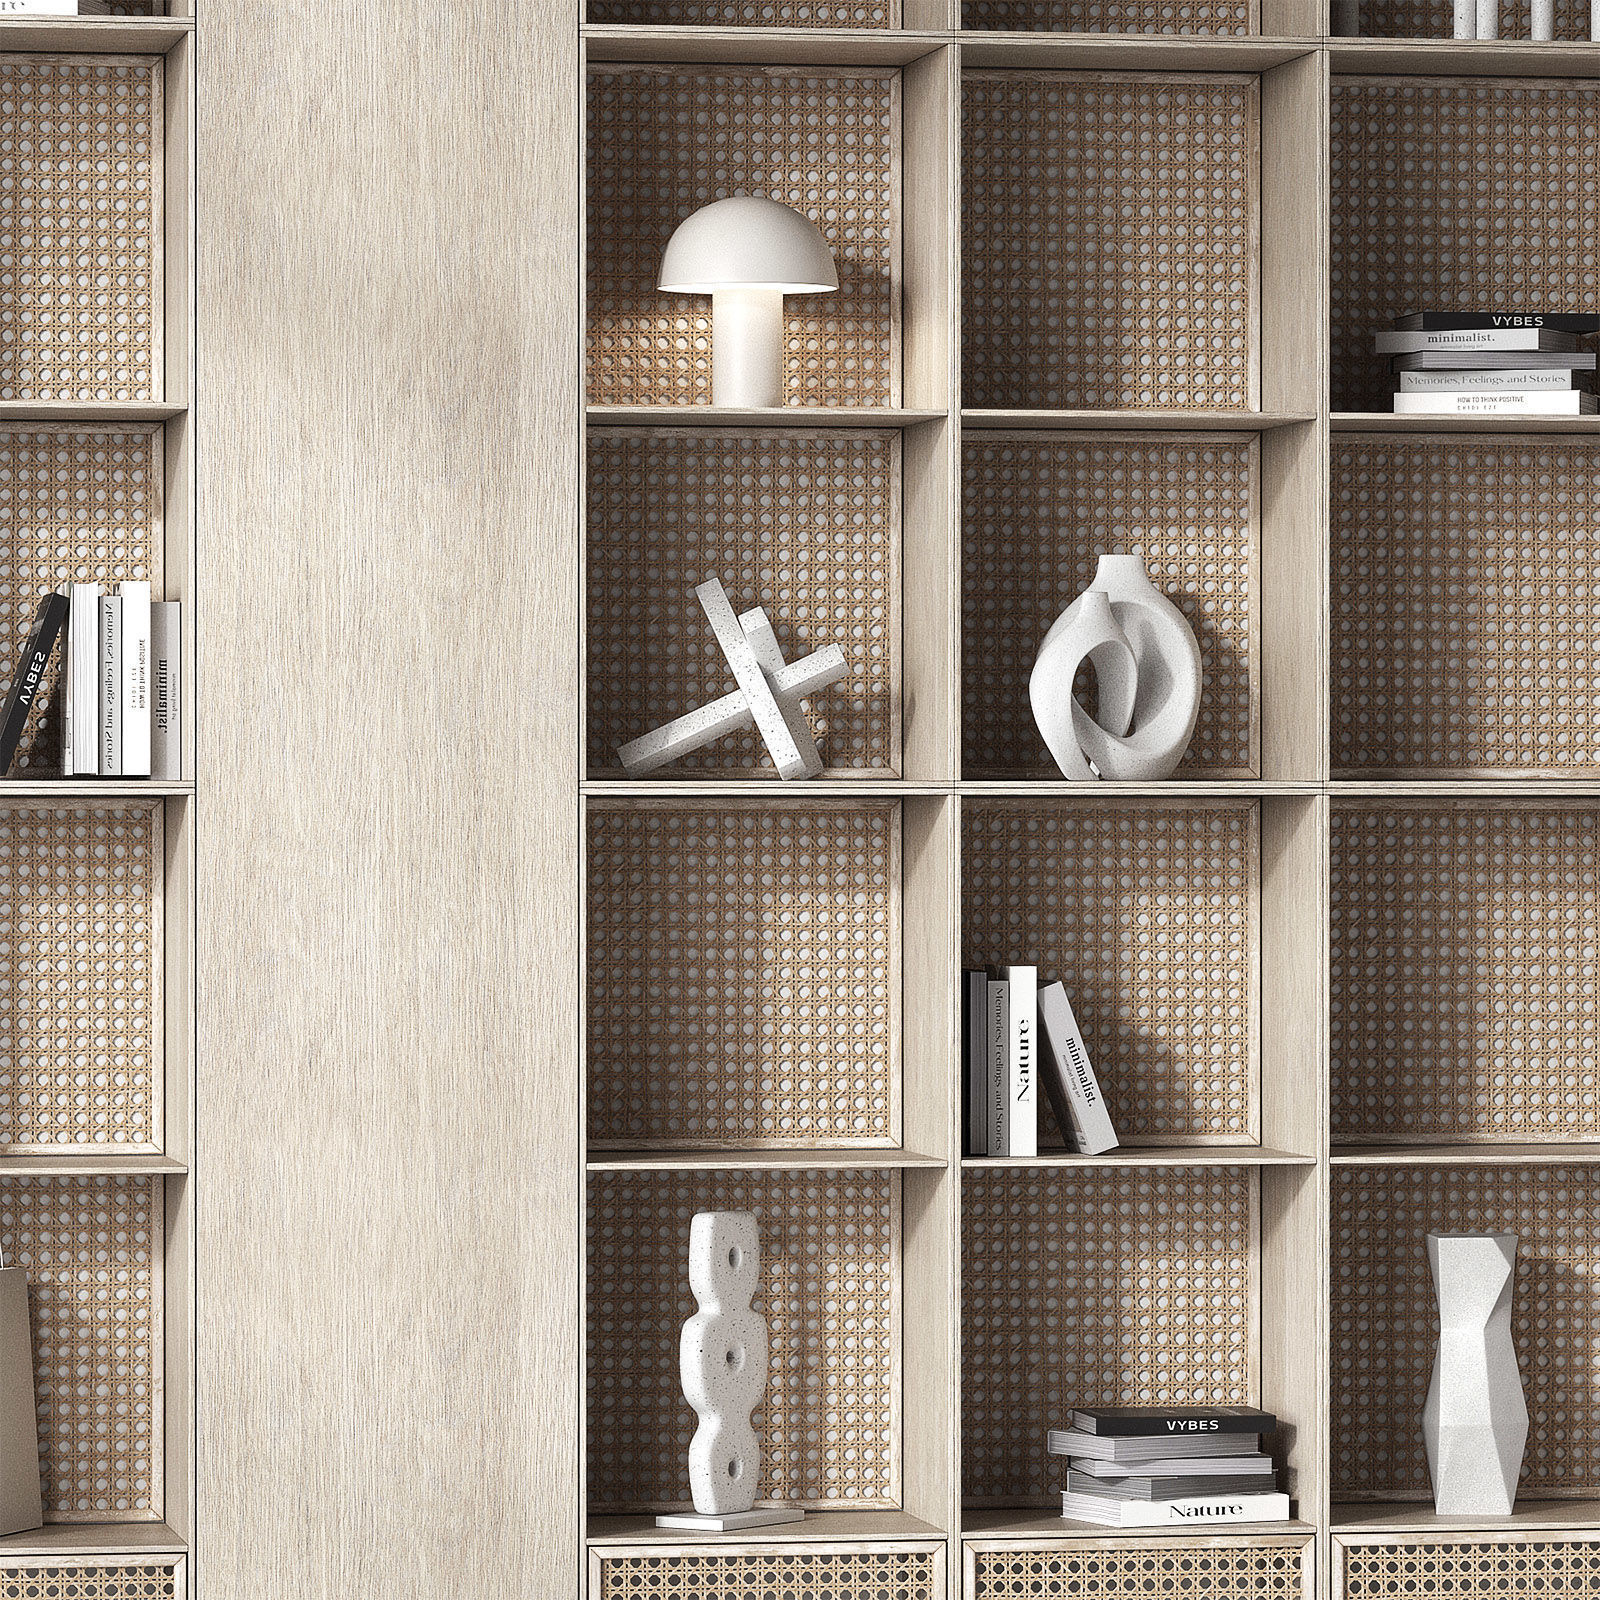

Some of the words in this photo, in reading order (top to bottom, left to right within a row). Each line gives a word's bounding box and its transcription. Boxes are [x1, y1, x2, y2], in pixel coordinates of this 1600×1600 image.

[1492, 316, 1544, 327] VYBES
[1427, 333, 1495, 343] minimalist.
[1407, 376, 1460, 385] Memories,
[1462, 375, 1504, 385] Feelings
[1507, 375, 1527, 383] and
[1529, 375, 1566, 383] Stories
[995, 988, 1004, 1042] Memories,
[994, 1044, 1004, 1087] Feelings
[1017, 1019, 1029, 1102] Nature
[1065, 1037, 1096, 1107] minimalist.
[995, 1090, 1004, 1110] and
[995, 1113, 1004, 1150] Stories
[1166, 1420, 1219, 1431] VYBES
[1170, 1504, 1243, 1518] Nature
